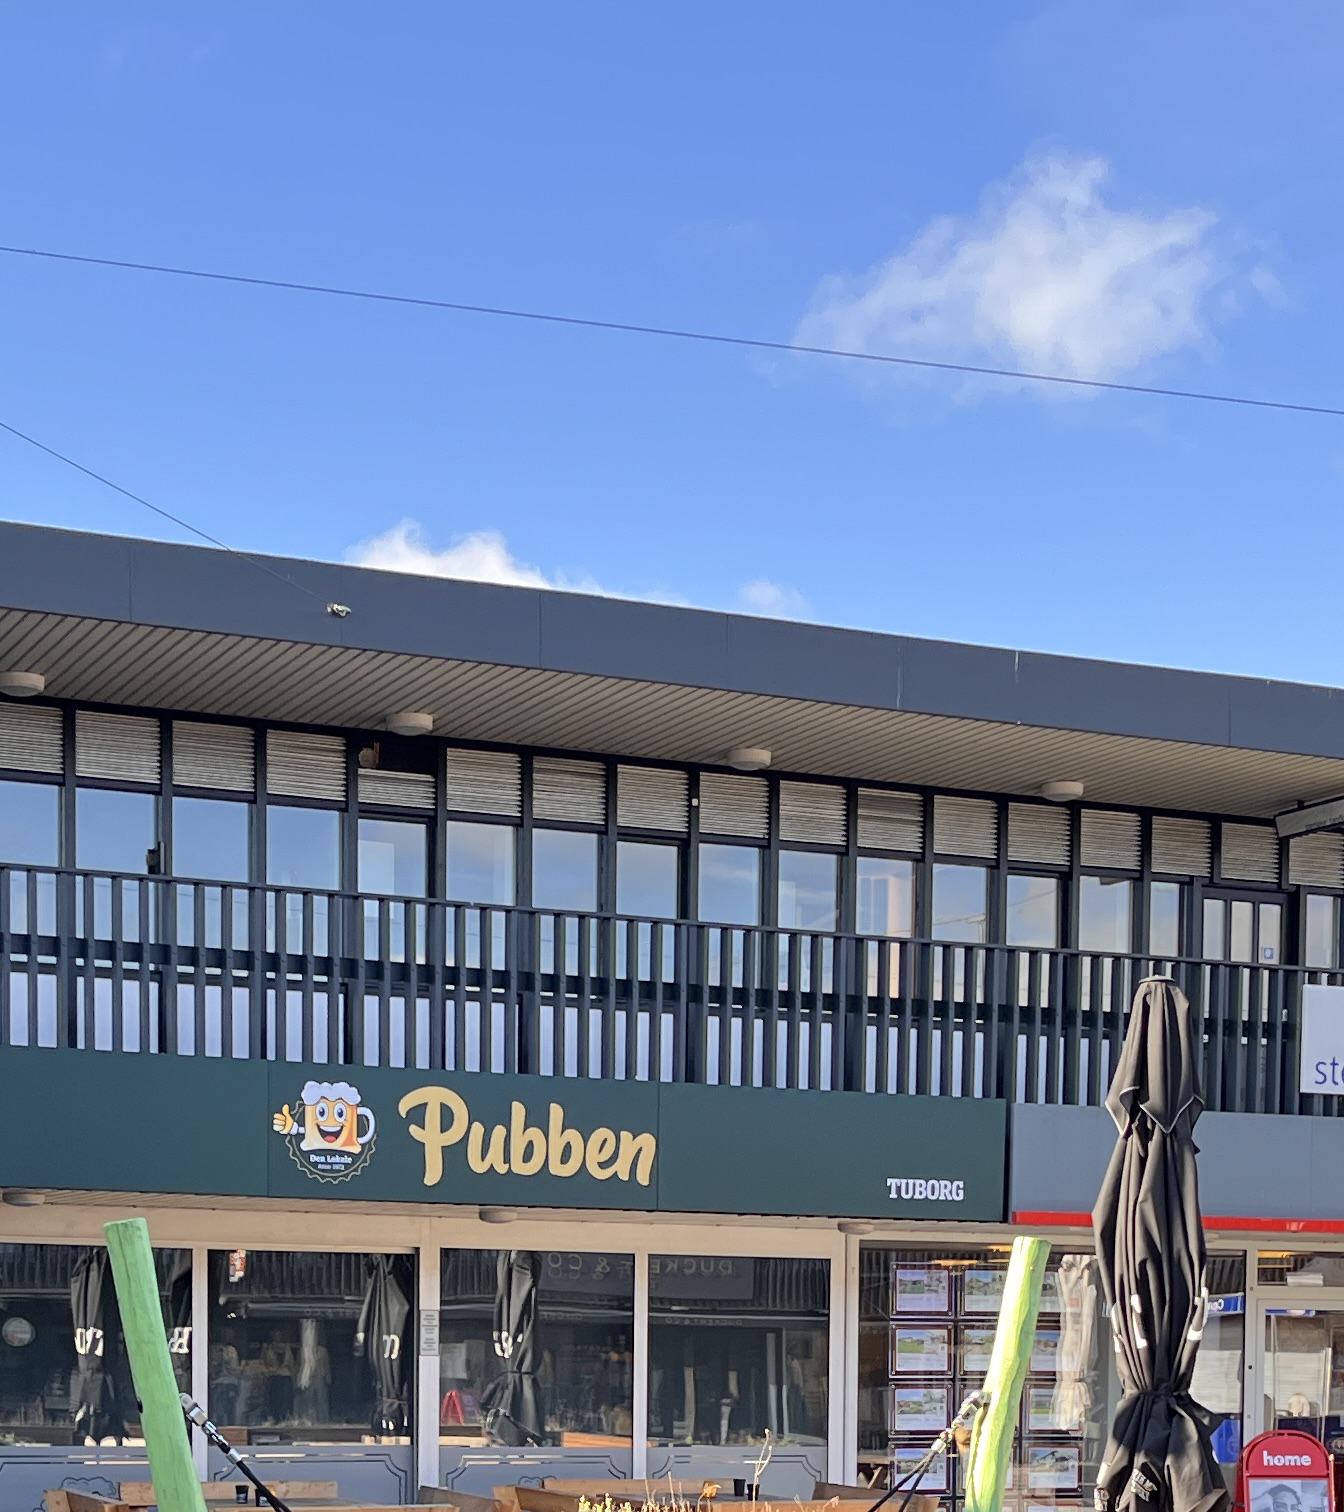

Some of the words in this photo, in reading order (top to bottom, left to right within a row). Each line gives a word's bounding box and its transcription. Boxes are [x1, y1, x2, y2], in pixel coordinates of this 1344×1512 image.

[398, 1085, 656, 1187] Pubben
[886, 1178, 964, 1201] TUBORG
[1262, 1450, 1312, 1466] home
